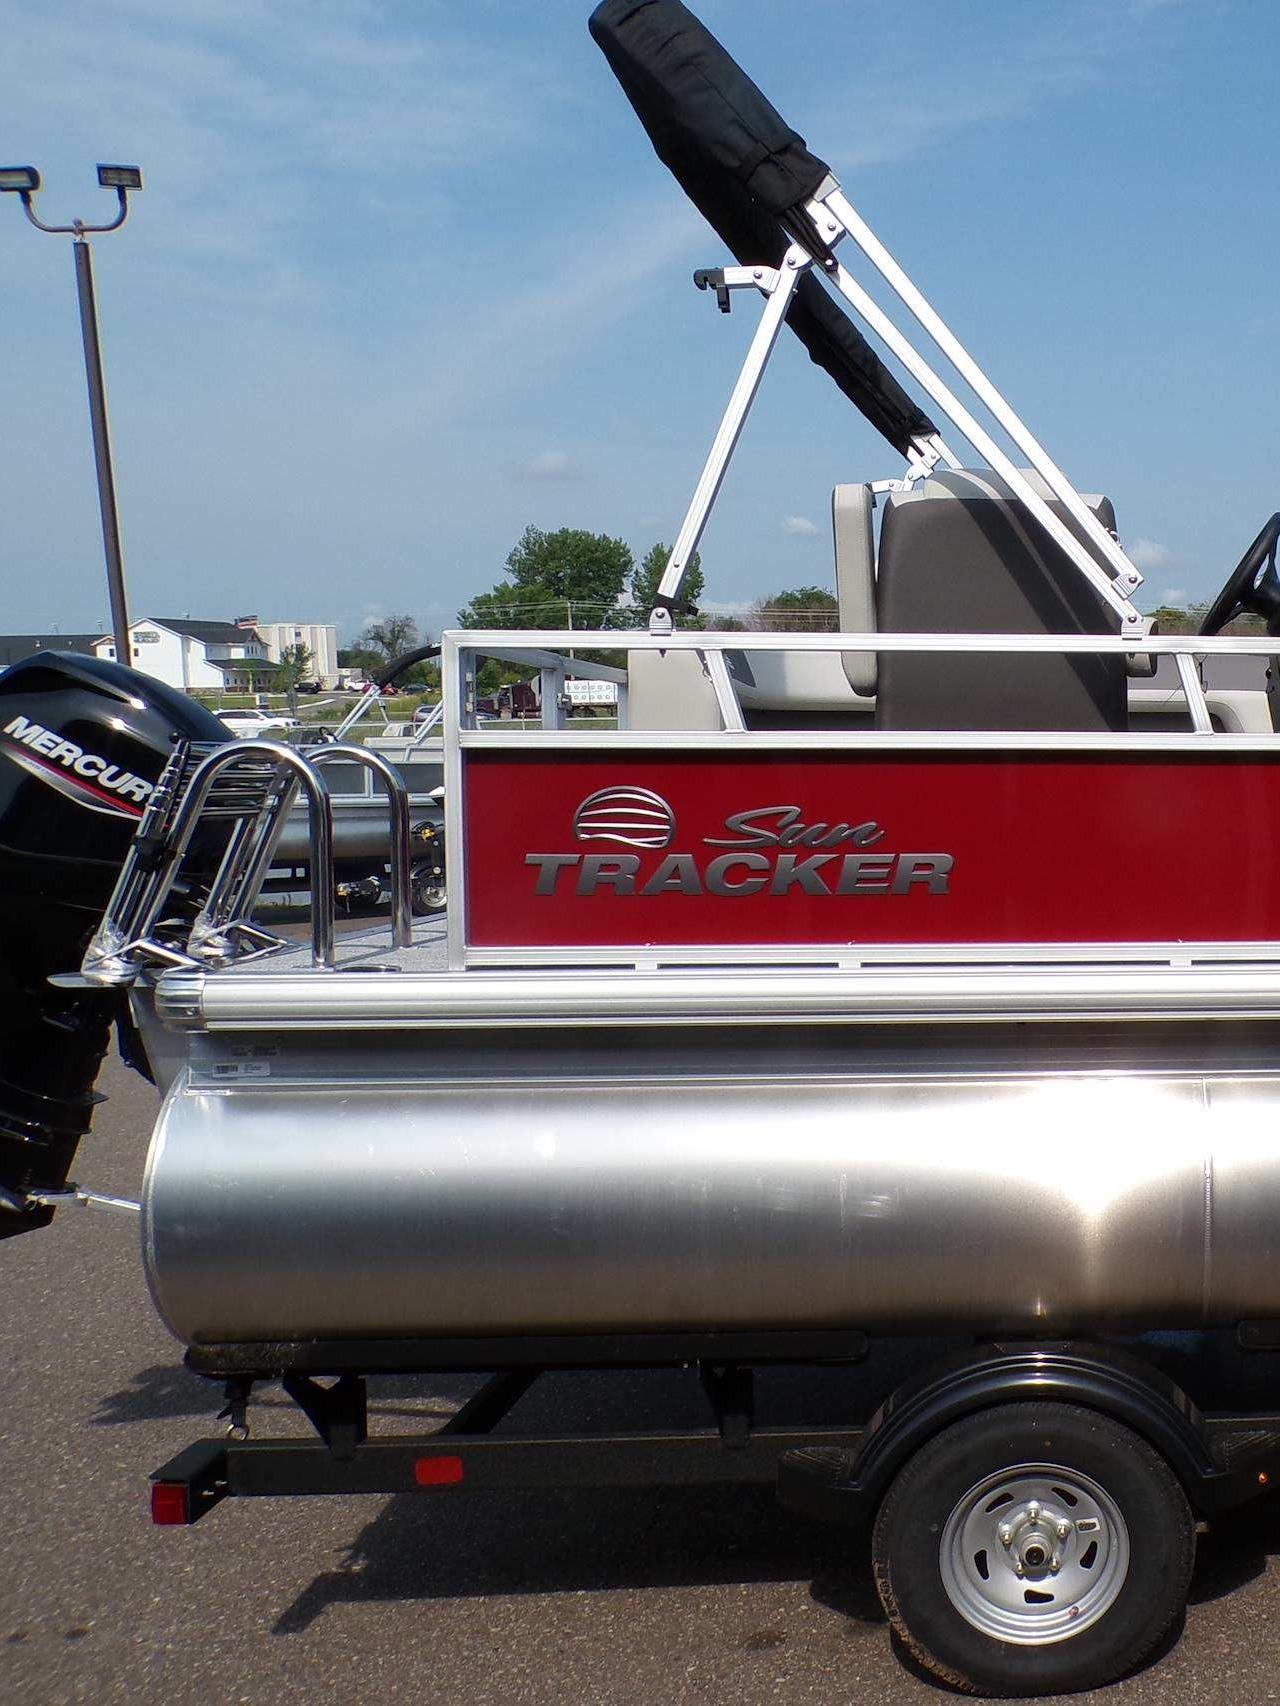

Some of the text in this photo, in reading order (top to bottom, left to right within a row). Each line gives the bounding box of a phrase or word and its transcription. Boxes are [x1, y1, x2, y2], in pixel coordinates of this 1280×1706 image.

[3, 715, 155, 802] MERCUR
[702, 805, 885, 849] Sun
[524, 852, 955, 897] TRACKER
